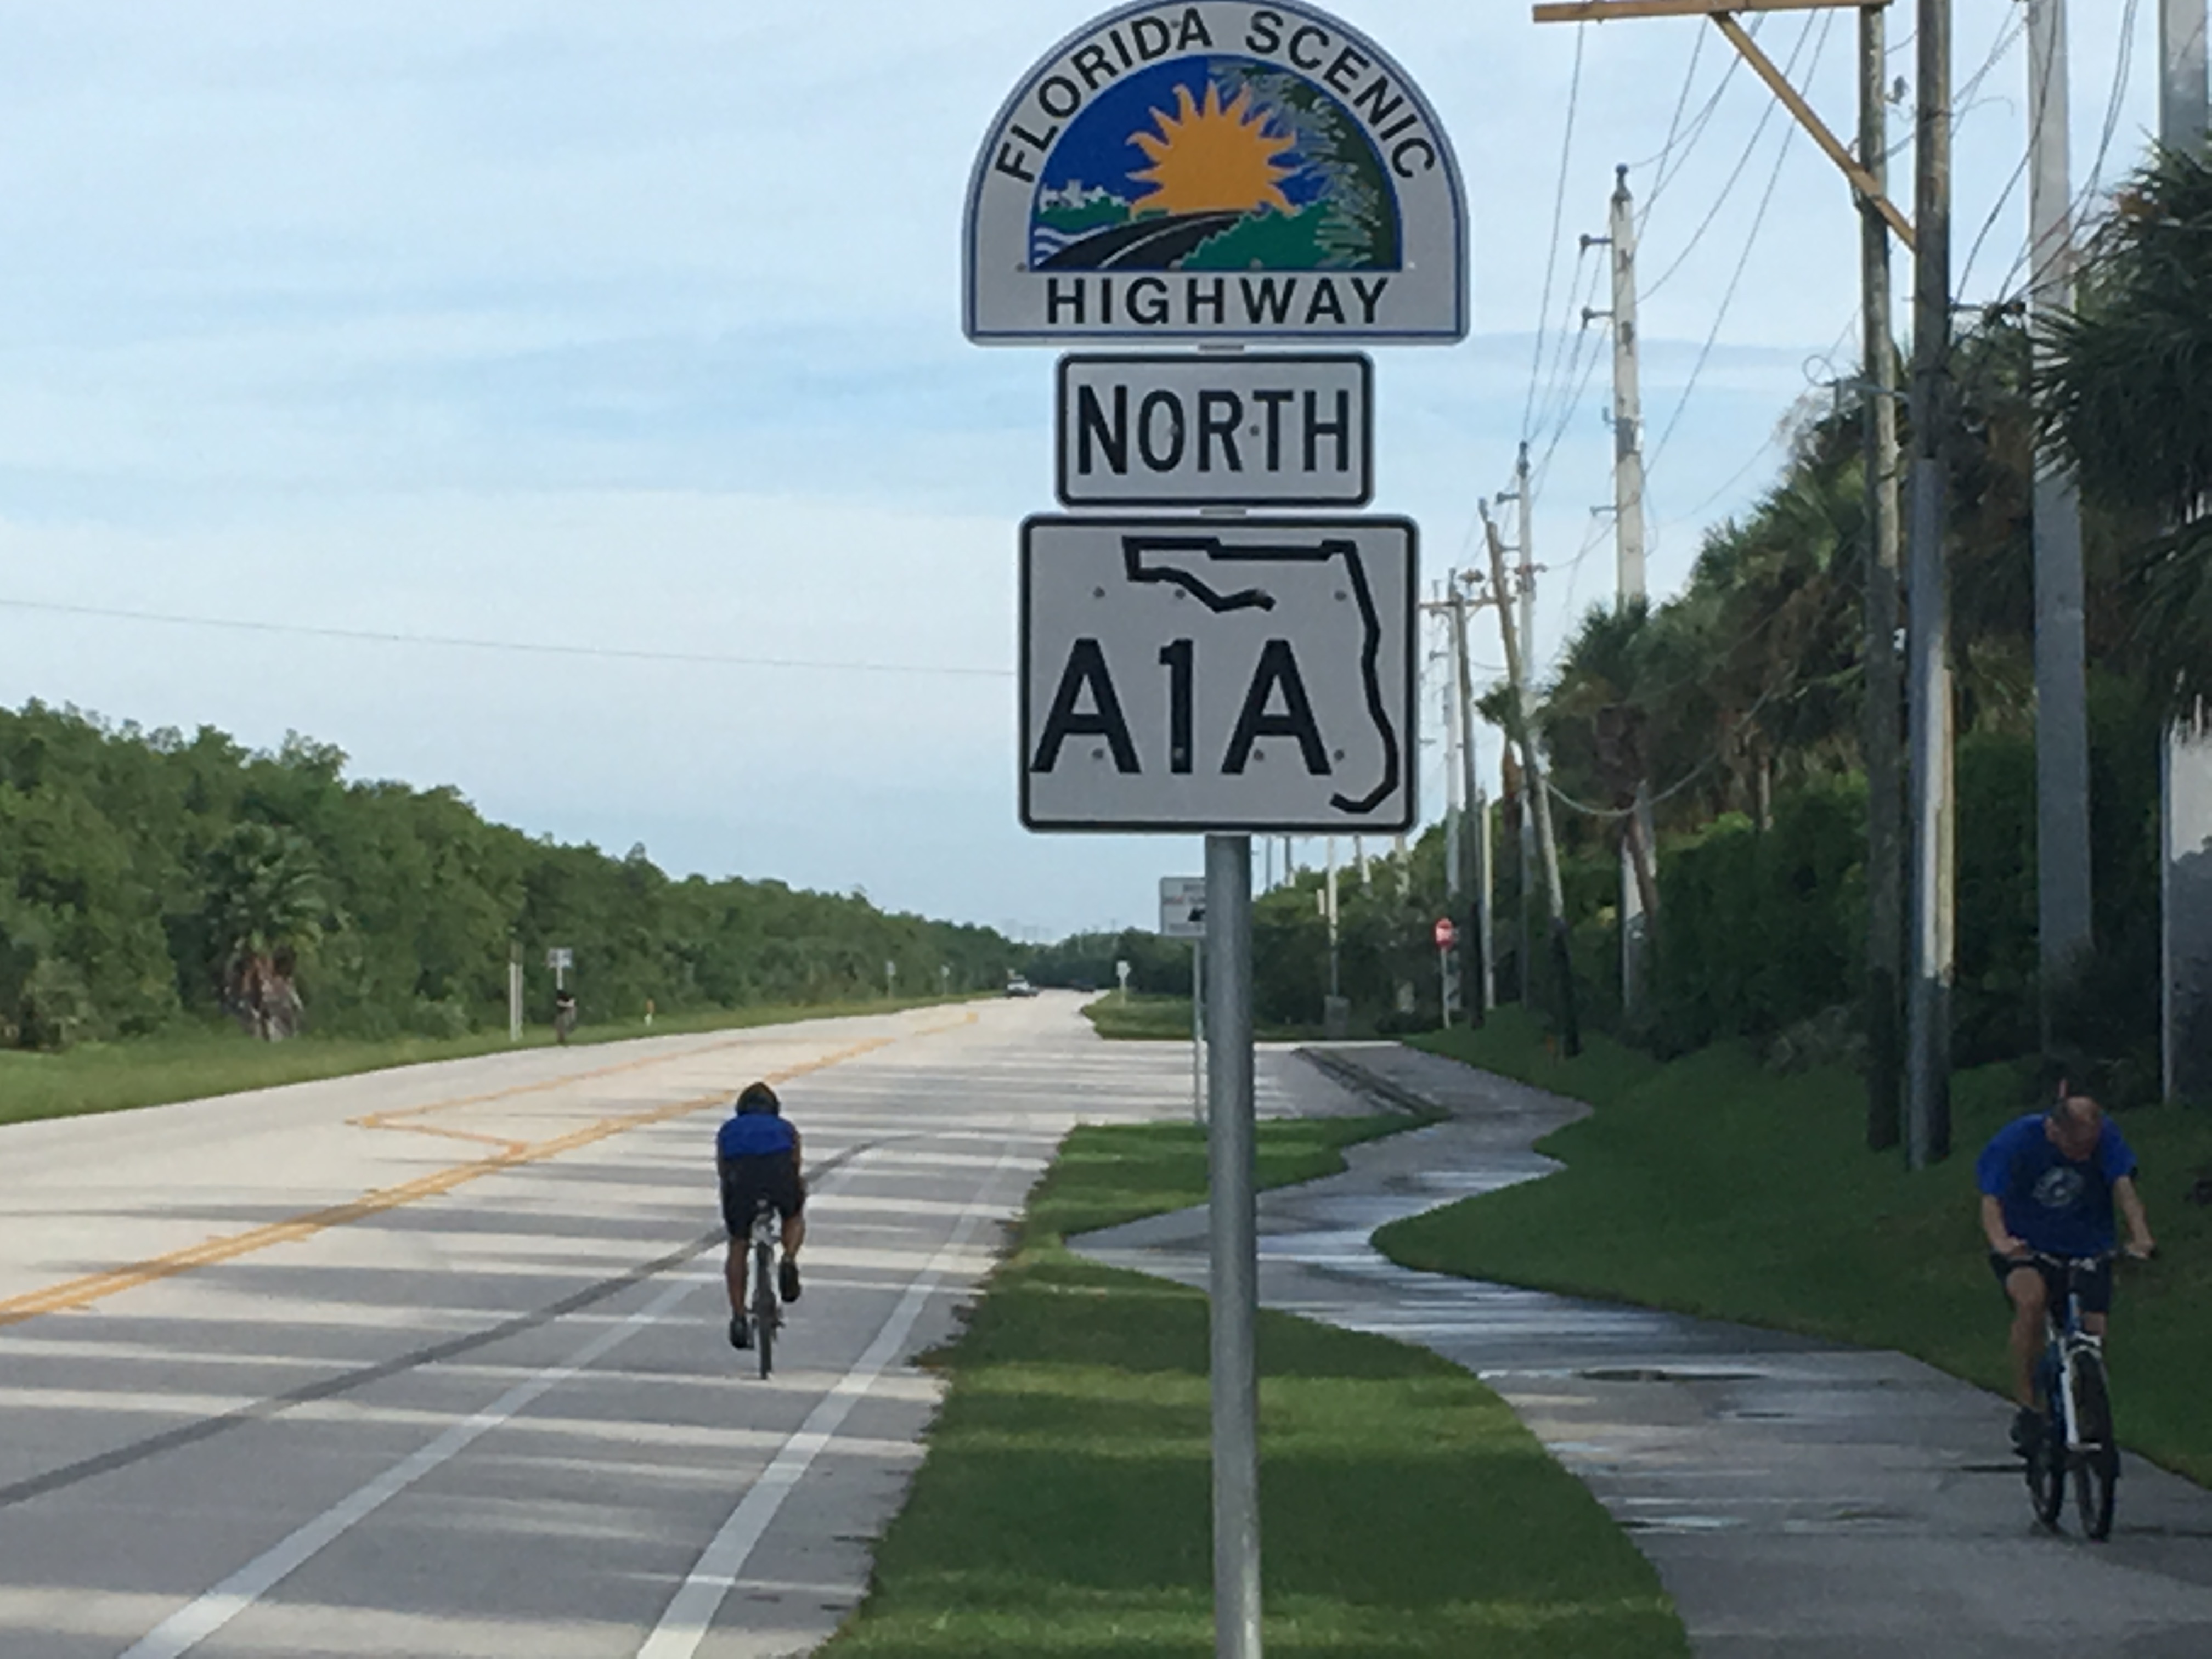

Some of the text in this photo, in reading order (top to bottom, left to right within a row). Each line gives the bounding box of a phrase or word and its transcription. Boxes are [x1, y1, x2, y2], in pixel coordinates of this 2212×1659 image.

[996, 8, 1435, 182] FLORIDA SCENIC
[1047, 277, 1389, 324] HIGHWAY
[1078, 385, 1348, 474] NORTH
[1029, 639, 1331, 774] A1A
